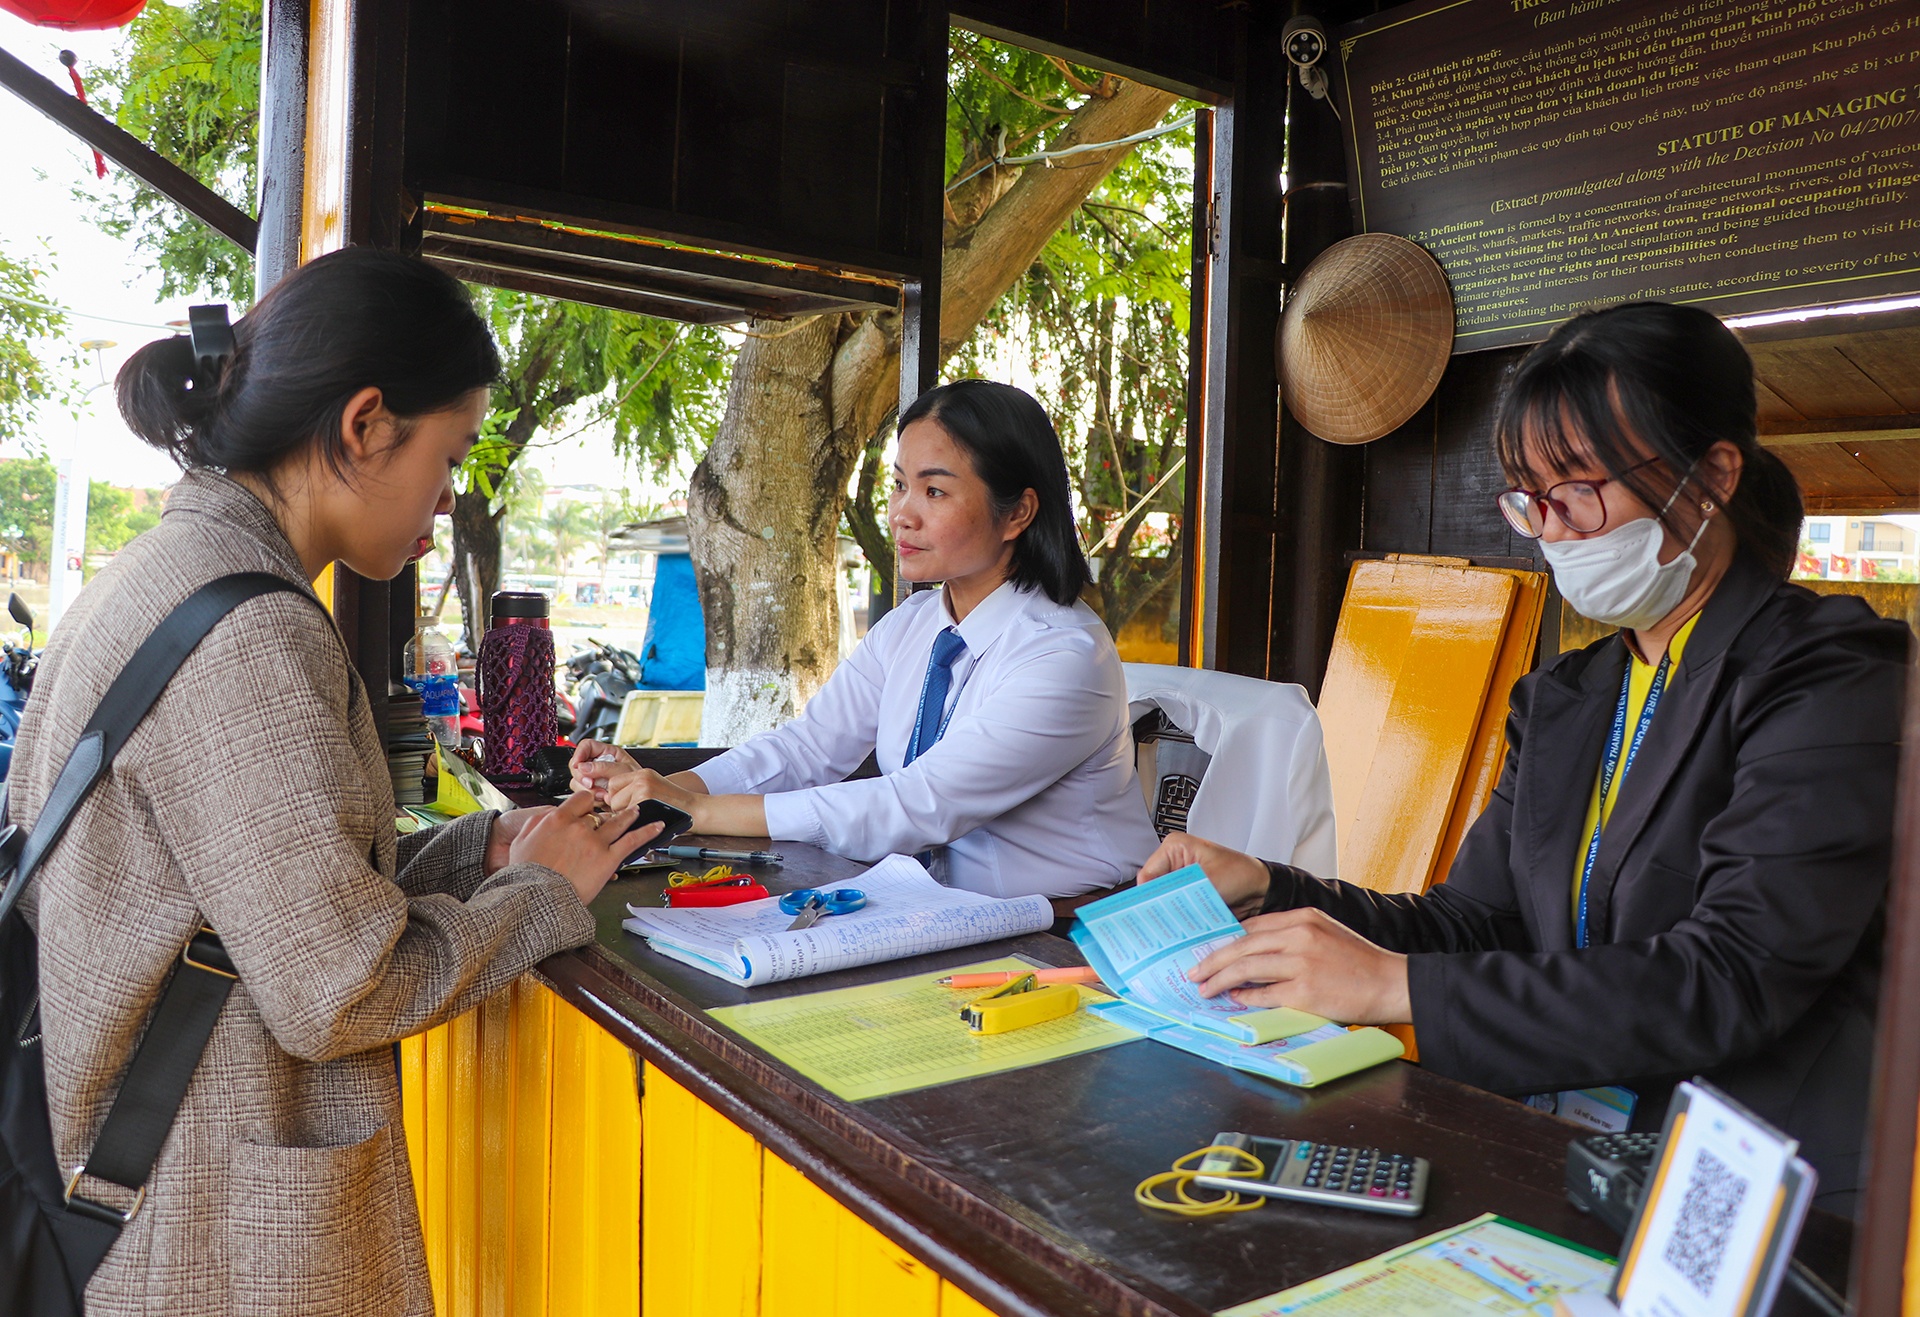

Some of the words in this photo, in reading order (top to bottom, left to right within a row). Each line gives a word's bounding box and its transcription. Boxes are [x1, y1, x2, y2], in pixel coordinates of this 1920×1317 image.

[1657, 124, 1744, 156] STATUTE
[1748, 117, 1776, 135] OF
[1781, 87, 1906, 129] MANAGING
[1437, 232, 1476, 247] Ancient
[1478, 227, 1504, 238] town
[1507, 223, 1516, 232] is
[1519, 214, 1555, 230] formed
[1558, 212, 1572, 223] by
[1584, 194, 1661, 217] concentration
[1664, 188, 1680, 200] of
[1681, 172, 1760, 197] architectural
[1765, 157, 1846, 180] monuments
[1850, 150, 1869, 163] of
[1490, 193, 1538, 214] (Extract
[1539, 172, 1624, 206] promulgated
[1626, 167, 1666, 184] along
[1670, 155, 1701, 173] with
[1705, 151, 1730, 167] the
[1733, 137, 1804, 161] Decision
[1809, 128, 1834, 145] No
[1568, 218, 1601, 232] traffic
[1663, 197, 1717, 214] drainage
[1838, 166, 1861, 180] old
[1416, 230, 1428, 241] 2:
[1430, 219, 1484, 237] Definitions
[1474, 252, 1501, 263] when
[1504, 244, 1544, 257] visiting
[1546, 239, 1564, 249] the
[1567, 233, 1588, 245] Hoi
[1590, 231, 1608, 241] An
[1610, 221, 1658, 237] Ancient
[1702, 198, 1775, 220] traditional
[1779, 184, 1861, 206] occupation
[1478, 263, 1510, 275] tickets
[1512, 253, 1563, 268] according
[1566, 250, 1577, 258] to
[1580, 246, 1597, 256] the
[1600, 239, 1627, 252] local
[1630, 229, 1693, 247] stipulation
[1696, 222, 1719, 235] and
[1723, 217, 1759, 230] being
[1763, 205, 1810, 226] guided
[1814, 190, 1908, 214] thoughtfully.
[1454, 276, 1507, 291] organizers
[1510, 271, 1536, 281] have
[1538, 266, 1556, 276] the
[1559, 260, 1592, 273] rights
[1595, 254, 1618, 266] and
[1621, 238, 1716, 262] responsibilities
[1719, 233, 1738, 244] of:
[1492, 285, 1520, 298] rights
[1522, 279, 1541, 291] and
[1544, 274, 1588, 288] interests
[1592, 270, 1608, 280] for
[1611, 264, 1638, 277] their
[1640, 258, 1684, 272] tourists
[1687, 252, 1721, 263] when
[1724, 239, 1798, 258] conducting
[1803, 233, 1837, 245] them
[1842, 230, 1856, 239] to
[1861, 222, 1893, 235] visit
[1502, 306, 1546, 319] violating
[1549, 302, 1566, 312] the
[1568, 294, 1626, 312] provisions
[1628, 288, 1643, 300] of
[1644, 286, 1666, 298] this
[1716, 270, 1780, 287] according
[1785, 268, 1798, 277] to
[1802, 258, 1858, 274] severity
[1863, 253, 1882, 266] of
[1884, 251, 1907, 263] the
[1476, 297, 1528, 312] measures:
[1642, 669, 1665, 716] CULTURE,
